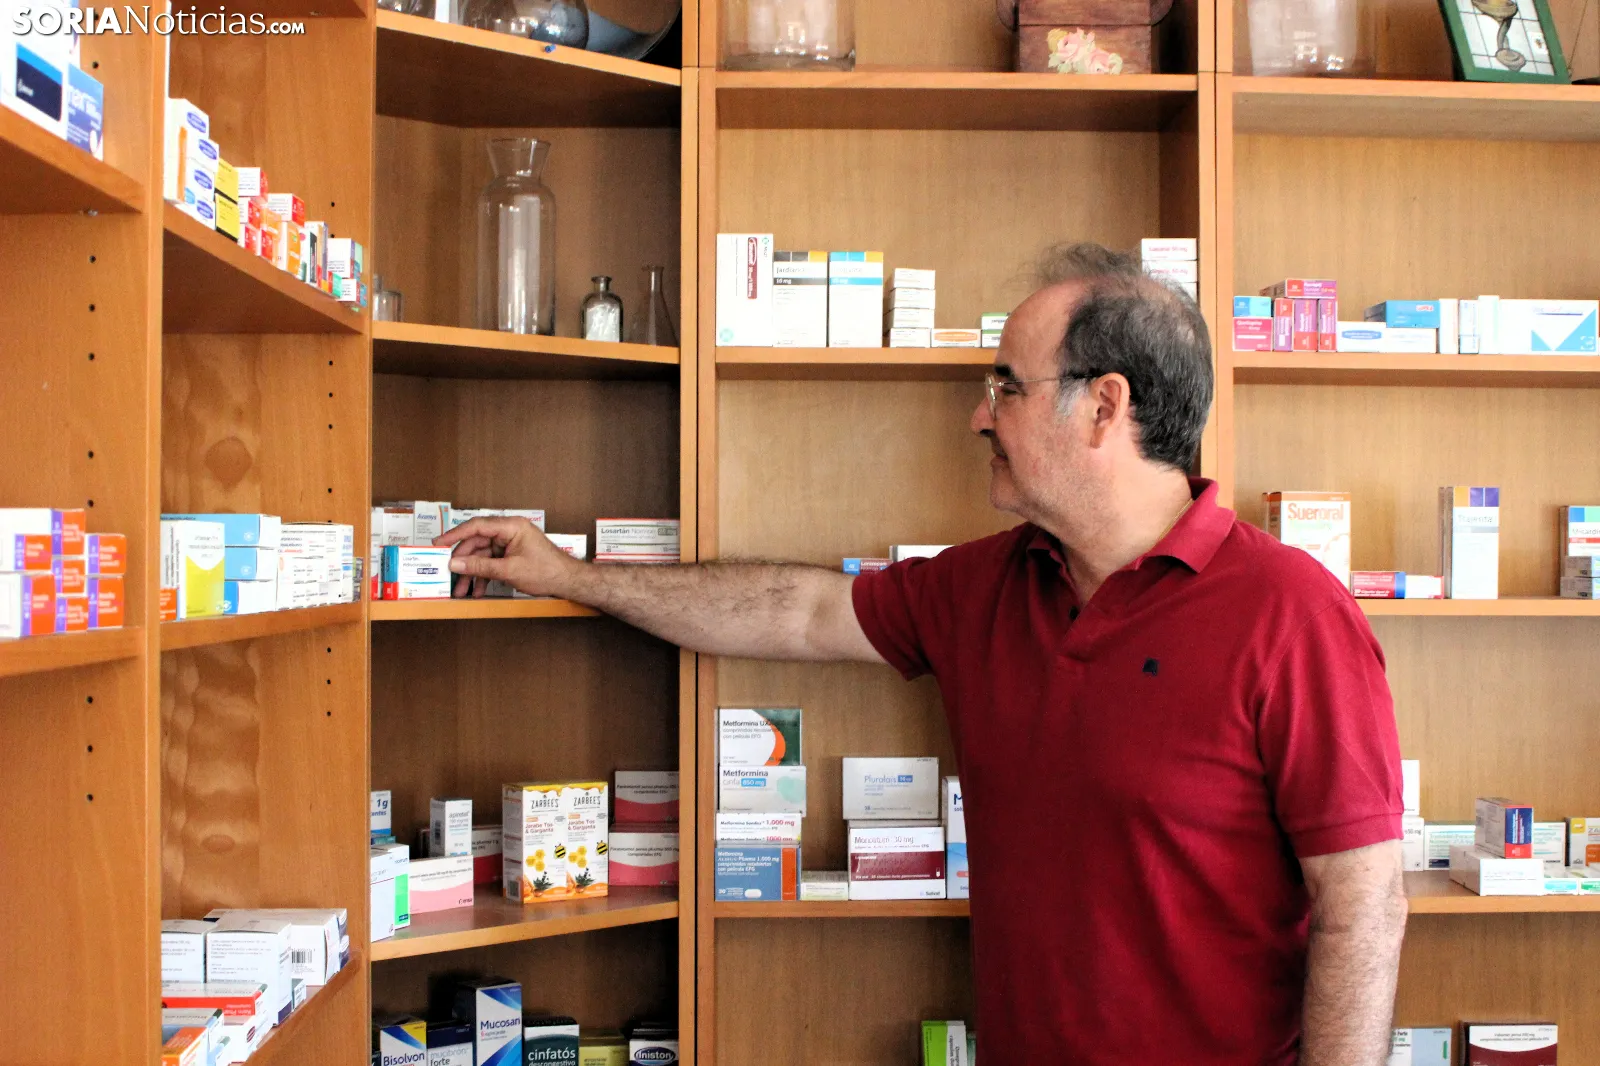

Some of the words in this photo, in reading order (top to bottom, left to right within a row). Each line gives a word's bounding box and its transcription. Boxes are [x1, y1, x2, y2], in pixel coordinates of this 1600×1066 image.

[1287, 502, 1344, 521] Sueroral
[723, 769, 769, 777] Metformina
[480, 1017, 521, 1030] Mucosan
[383, 1052, 425, 1066] Bisolvon
[528, 1046, 576, 1061] cinfatós
[430, 1058, 450, 1066] forte
